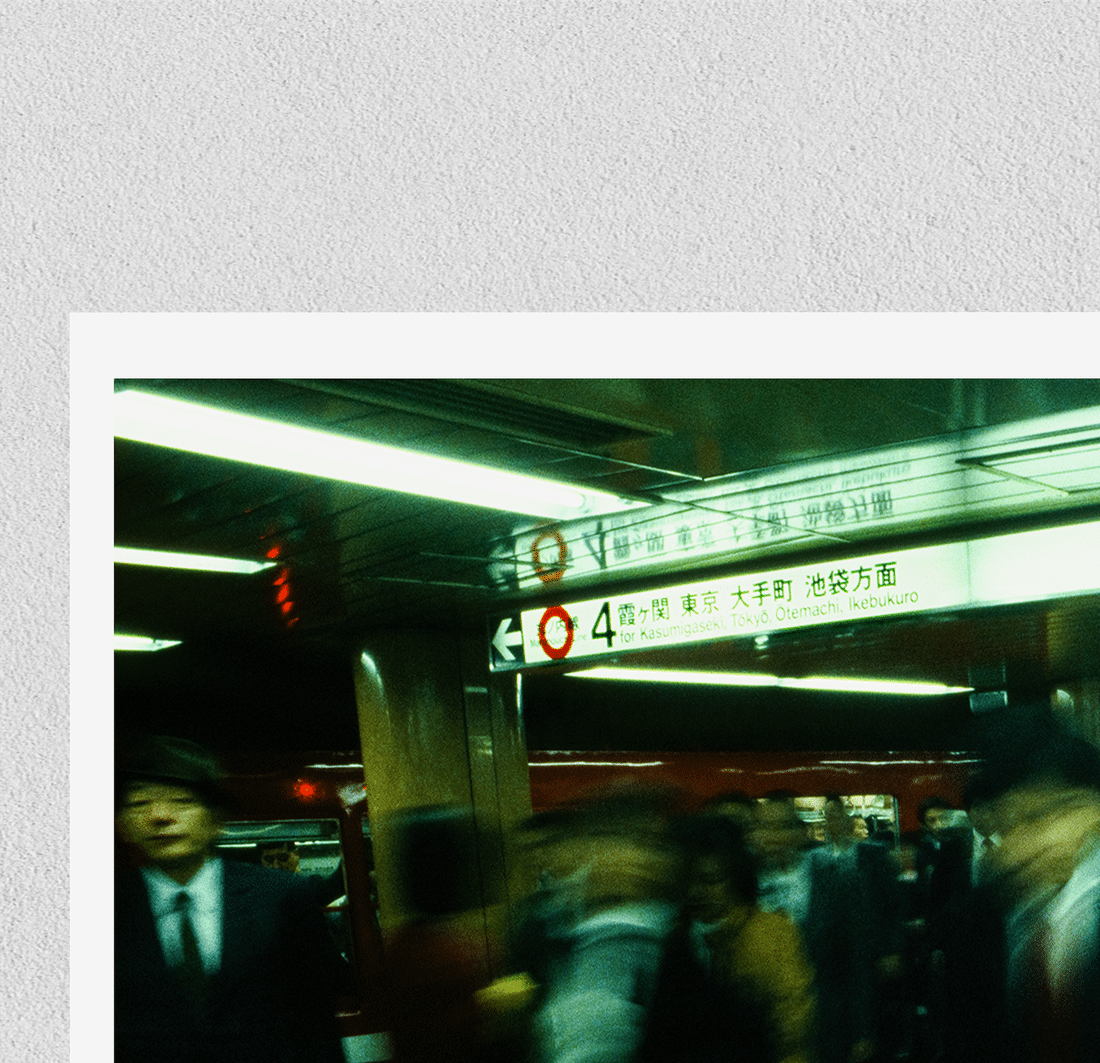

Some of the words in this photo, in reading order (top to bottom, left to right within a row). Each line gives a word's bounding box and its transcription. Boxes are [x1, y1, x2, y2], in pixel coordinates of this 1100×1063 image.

[591, 601, 617, 648] 4
[680, 591, 719, 617] 東京
[730, 579, 792, 610] 大手町
[805, 561, 897, 598] 池袋方面
[620, 629, 635, 644] for
[848, 591, 919, 611] Ikebukuro
